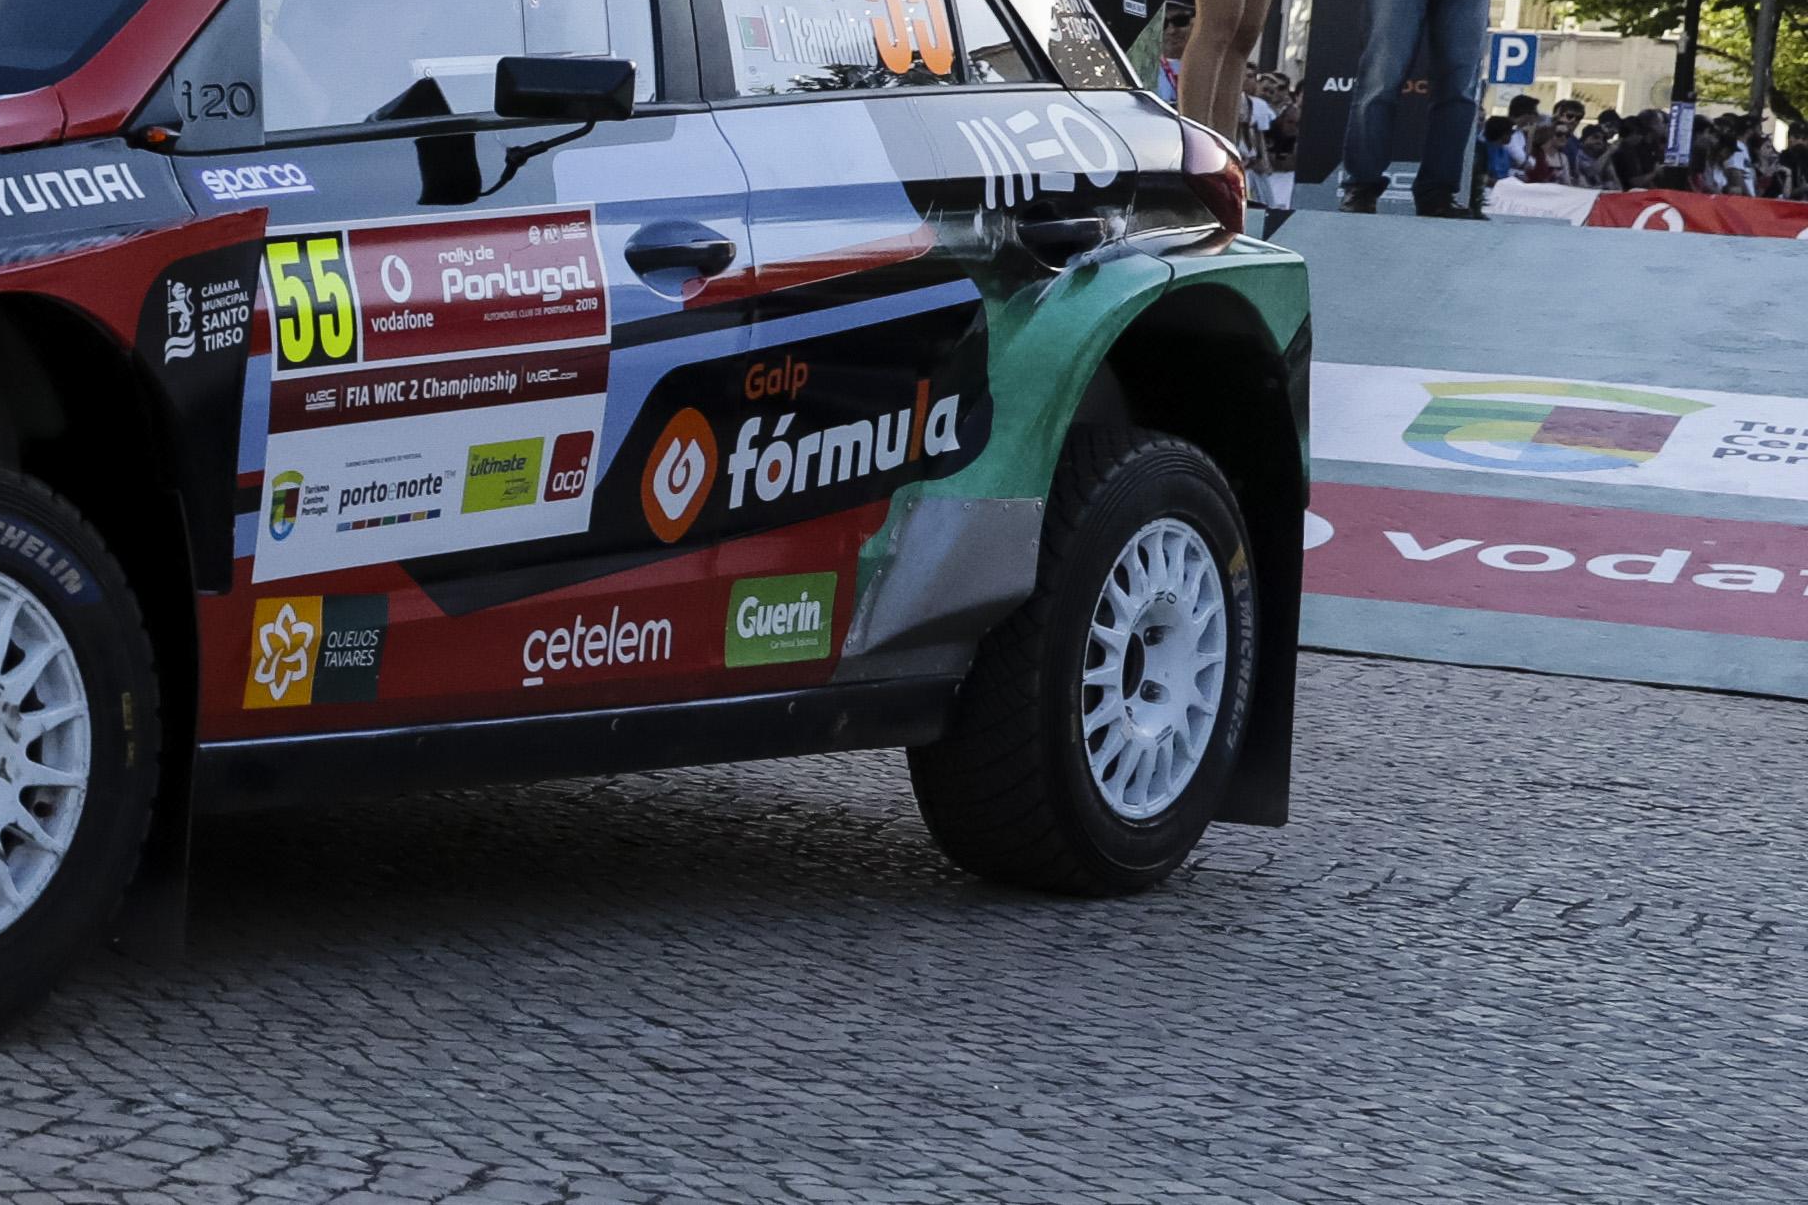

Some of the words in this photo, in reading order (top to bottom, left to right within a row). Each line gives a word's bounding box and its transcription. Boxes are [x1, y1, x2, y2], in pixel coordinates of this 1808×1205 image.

[1496, 37, 1530, 82] P
[180, 80, 257, 123] i20
[201, 162, 313, 199] sparco
[438, 247, 474, 267] rally
[475, 244, 495, 261] de
[201, 278, 241, 298] CÂMARA
[442, 256, 596, 303] Portugal
[201, 290, 250, 312] MUNICIPAL
[267, 238, 354, 363] 55
[575, 297, 598, 312] 2019
[202, 305, 249, 333] SANTO
[371, 309, 435, 333] vodafone
[202, 326, 244, 353] TIRSO
[345, 383, 370, 408] FIA
[373, 379, 406, 404] WRC
[409, 377, 419, 400] 2
[422, 370, 517, 400] Championship
[745, 354, 809, 401] Galp
[728, 379, 961, 510] fórmula
[470, 457, 527, 477] ultimate
[552, 469, 585, 494] acp
[1383, 530, 1808, 597] voda
[737, 591, 821, 639] Guerin
[326, 628, 379, 649] QUEIJOS
[523, 605, 671, 674] cetelem
[323, 649, 375, 668] TAVARES
